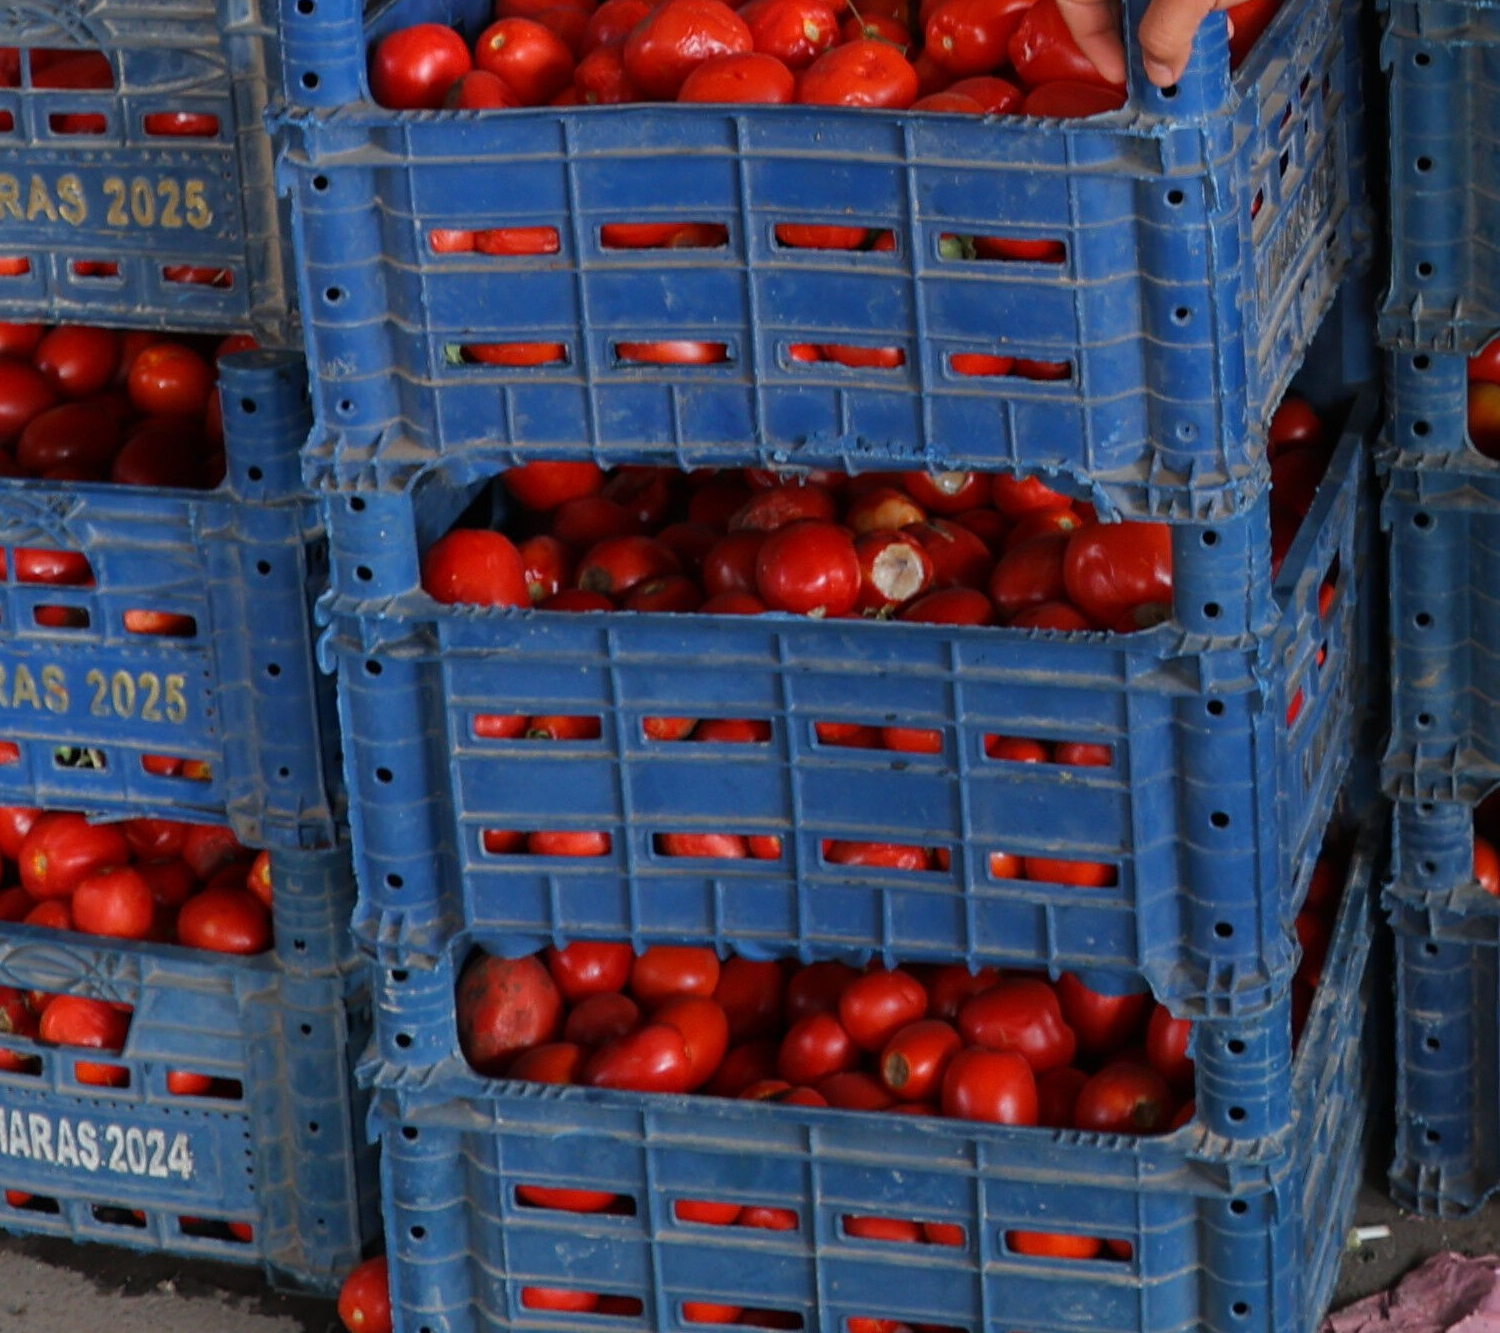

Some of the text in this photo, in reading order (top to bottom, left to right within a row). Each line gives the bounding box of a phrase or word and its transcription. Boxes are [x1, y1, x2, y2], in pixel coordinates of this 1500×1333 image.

[102, 175, 213, 229] 2025
[86, 668, 188, 724] 2025
[105, 1123, 194, 1181] 2024
